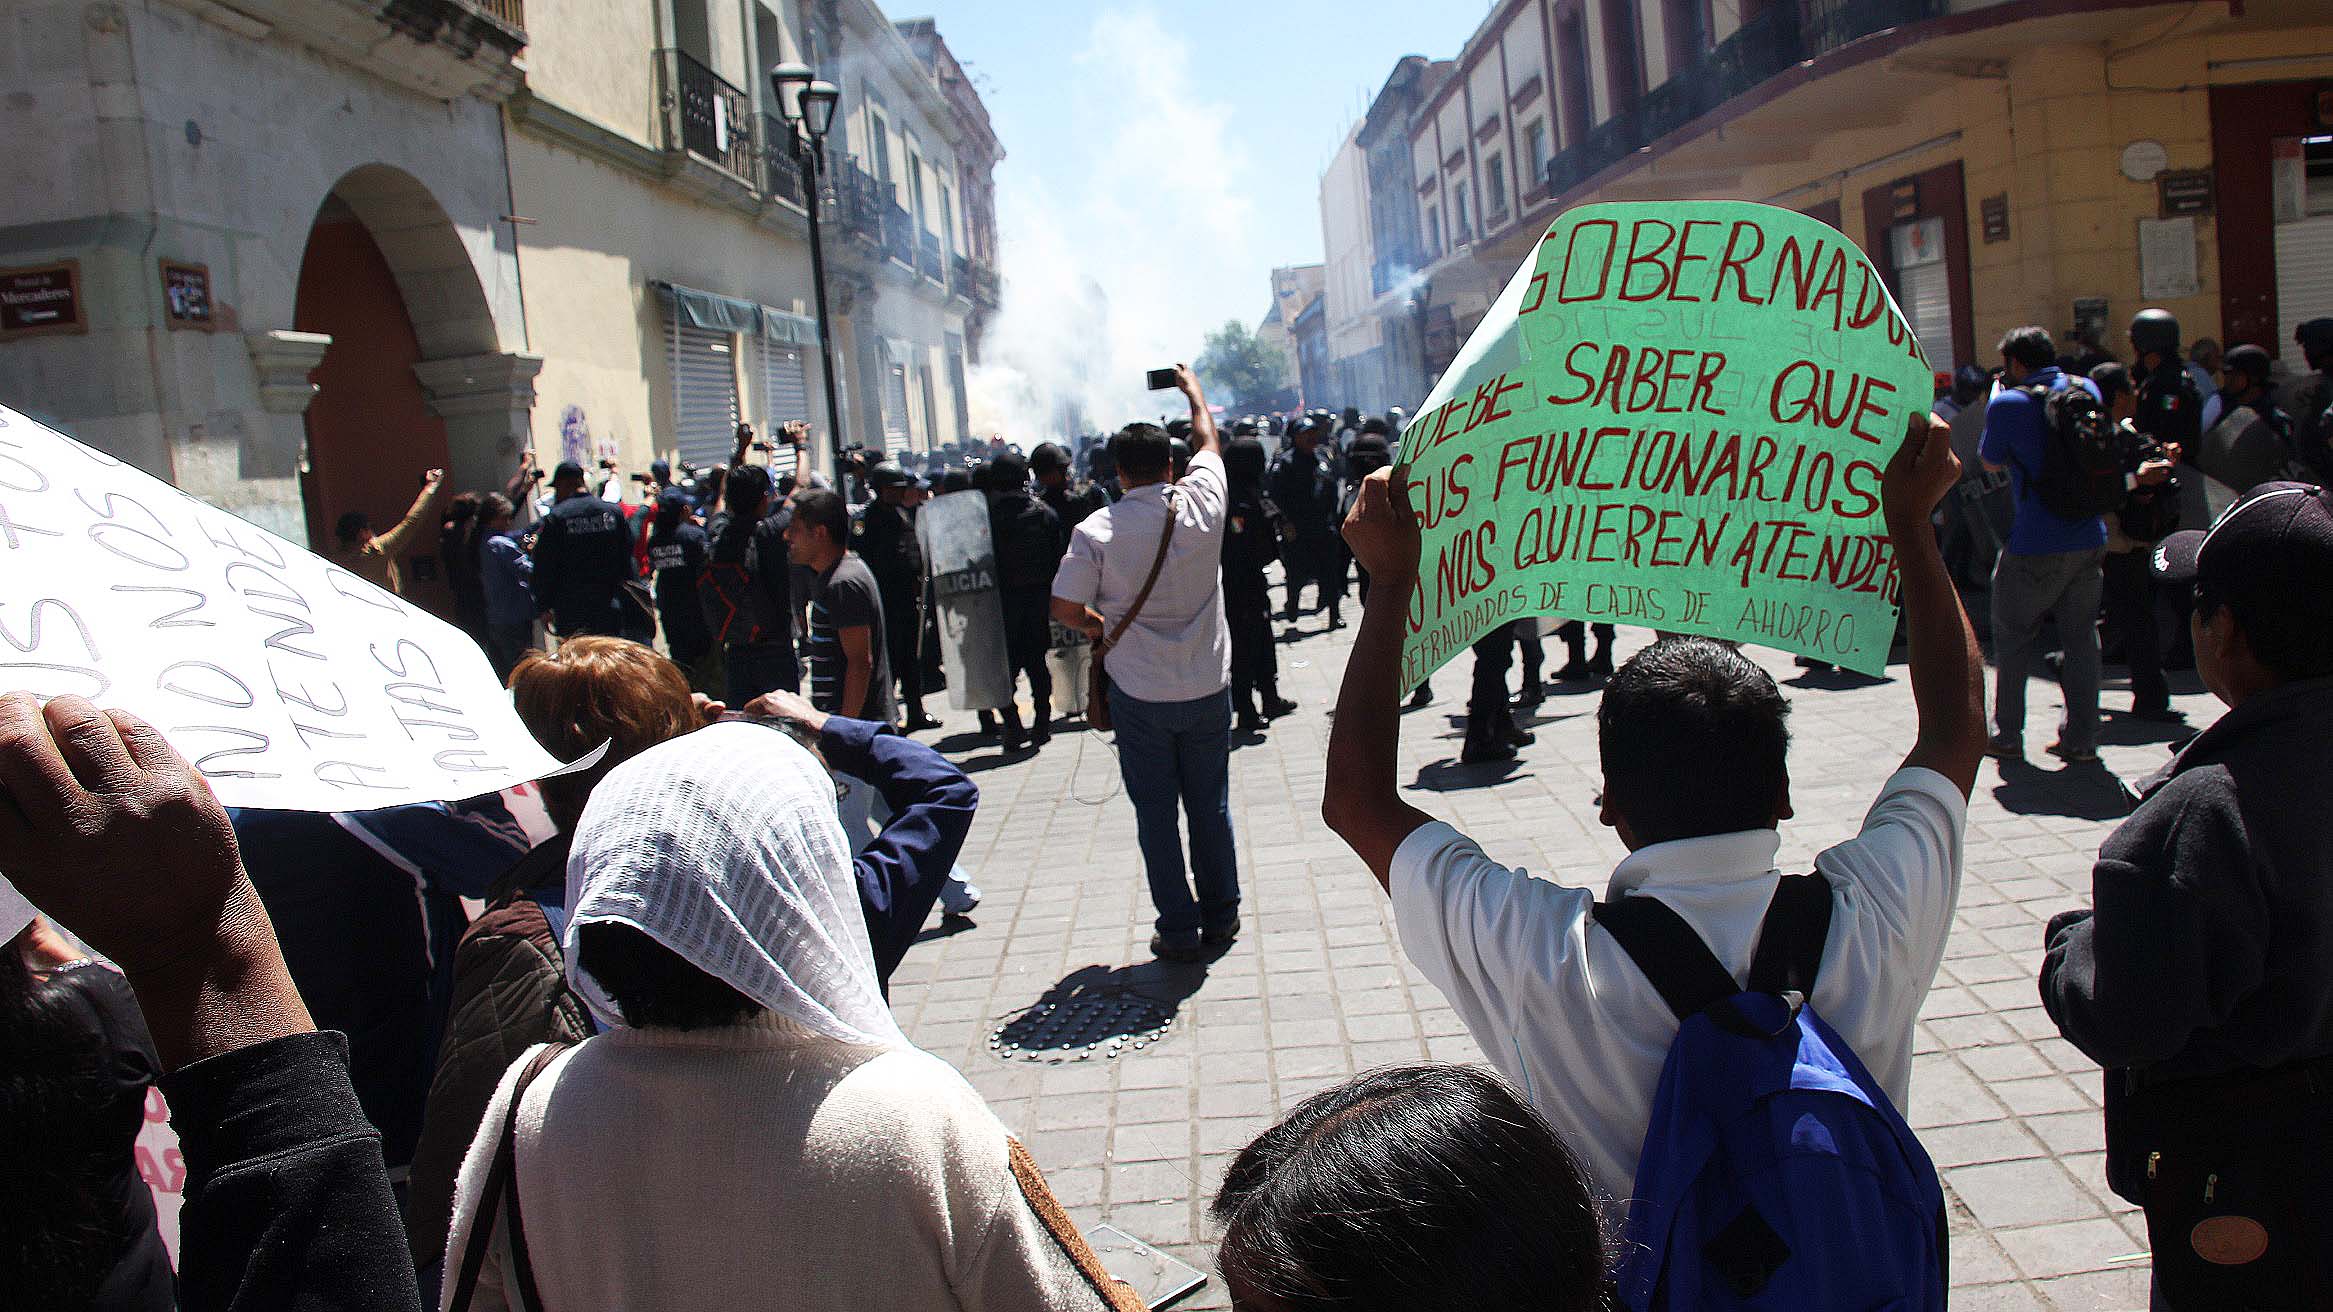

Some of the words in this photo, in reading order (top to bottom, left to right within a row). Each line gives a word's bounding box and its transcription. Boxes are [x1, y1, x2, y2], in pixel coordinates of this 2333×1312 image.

[1546, 341, 1726, 415] SABER
[1769, 360, 1897, 445] QUE
[1493, 427, 1885, 519] FUNCIONARIOS
[73, 488, 217, 629] NOS
[1436, 519, 1497, 619] NOS
[1514, 505, 1732, 570] QUIEREN
[1399, 584, 1528, 693] DEFRAUDADOS
[1536, 582, 1569, 612] DE
[1586, 584, 1666, 621] CAJAS
[1676, 589, 1712, 625] DE
[1736, 597, 1861, 655] AHORRO.
[156, 659, 283, 779] NO
